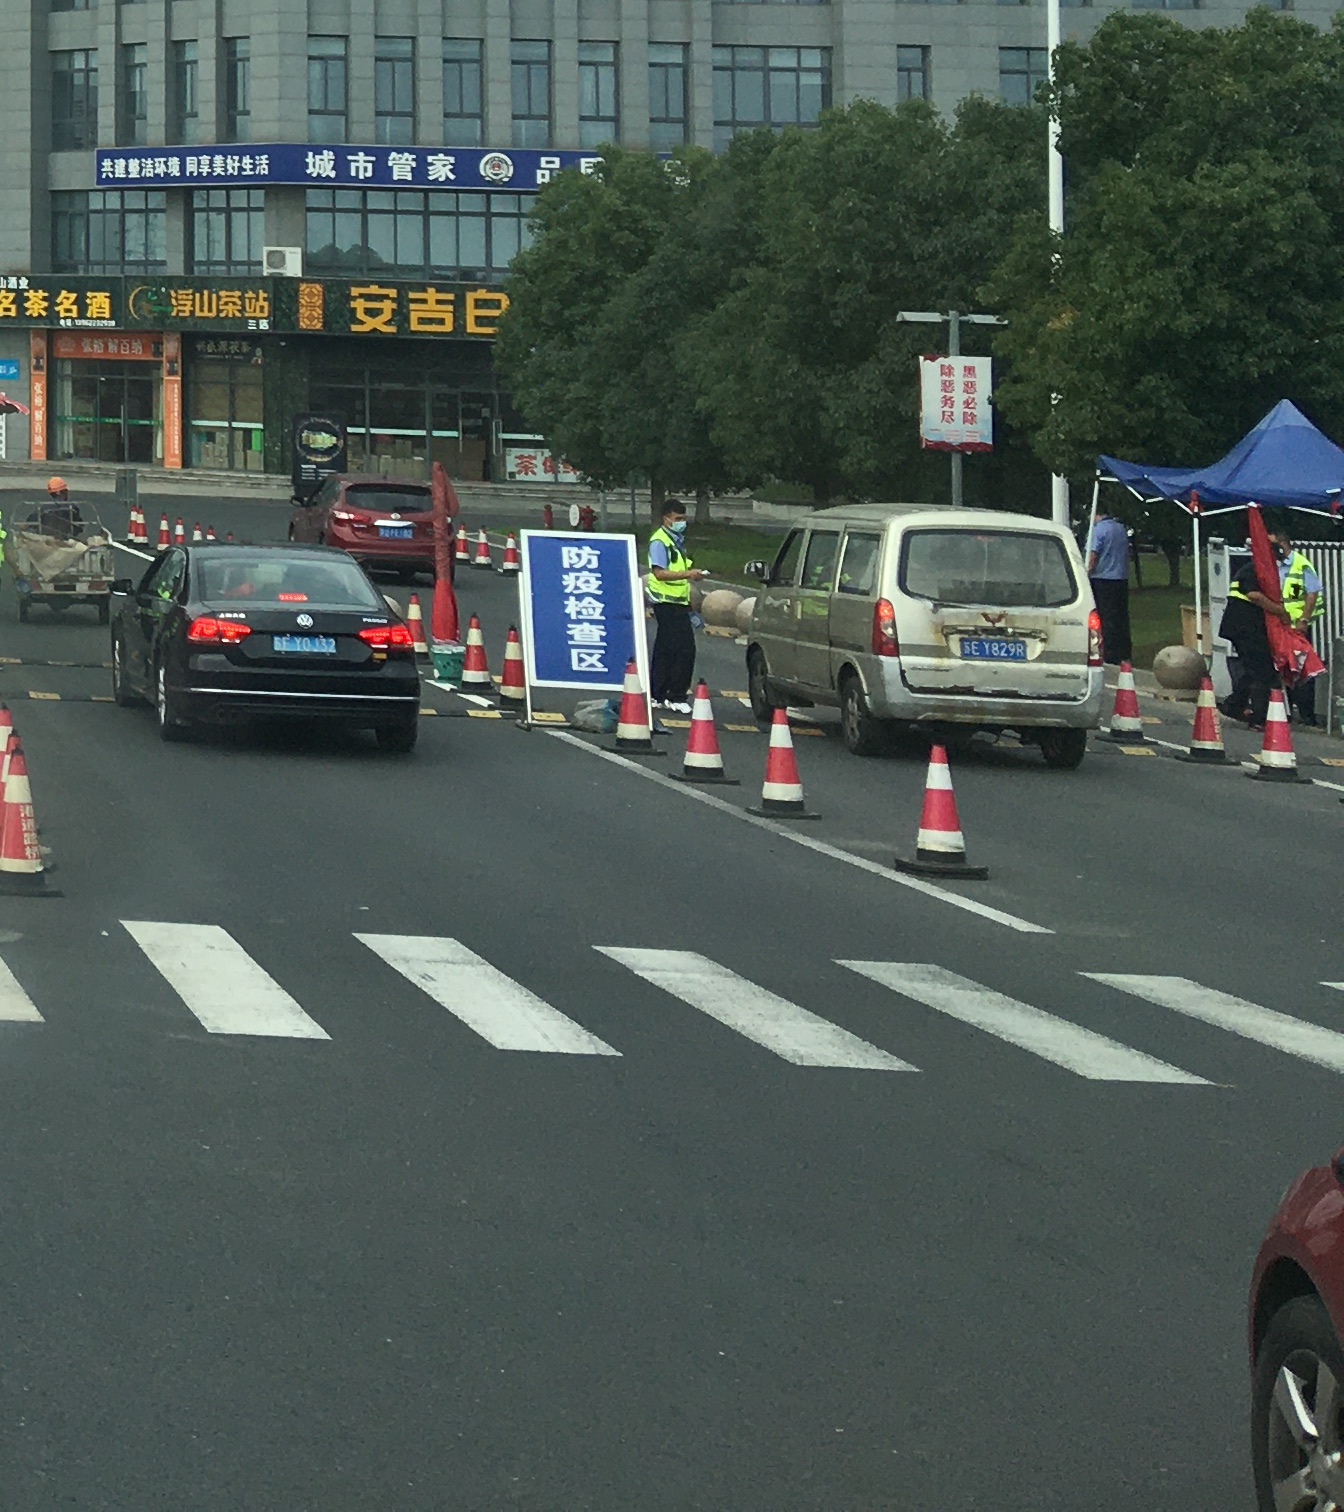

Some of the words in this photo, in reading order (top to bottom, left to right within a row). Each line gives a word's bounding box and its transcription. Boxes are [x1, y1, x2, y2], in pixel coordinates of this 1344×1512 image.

[101, 157, 181, 179] 共建整洁环境
[185, 155, 269, 176] 同享美好生活
[305, 150, 456, 182] 城市管家
[170, 288, 269, 319] 浮山茶站
[940, 364, 955, 424] 除恶务尽
[962, 365, 977, 425] 黑恶必除
[561, 546, 609, 673] 防疫检查区
